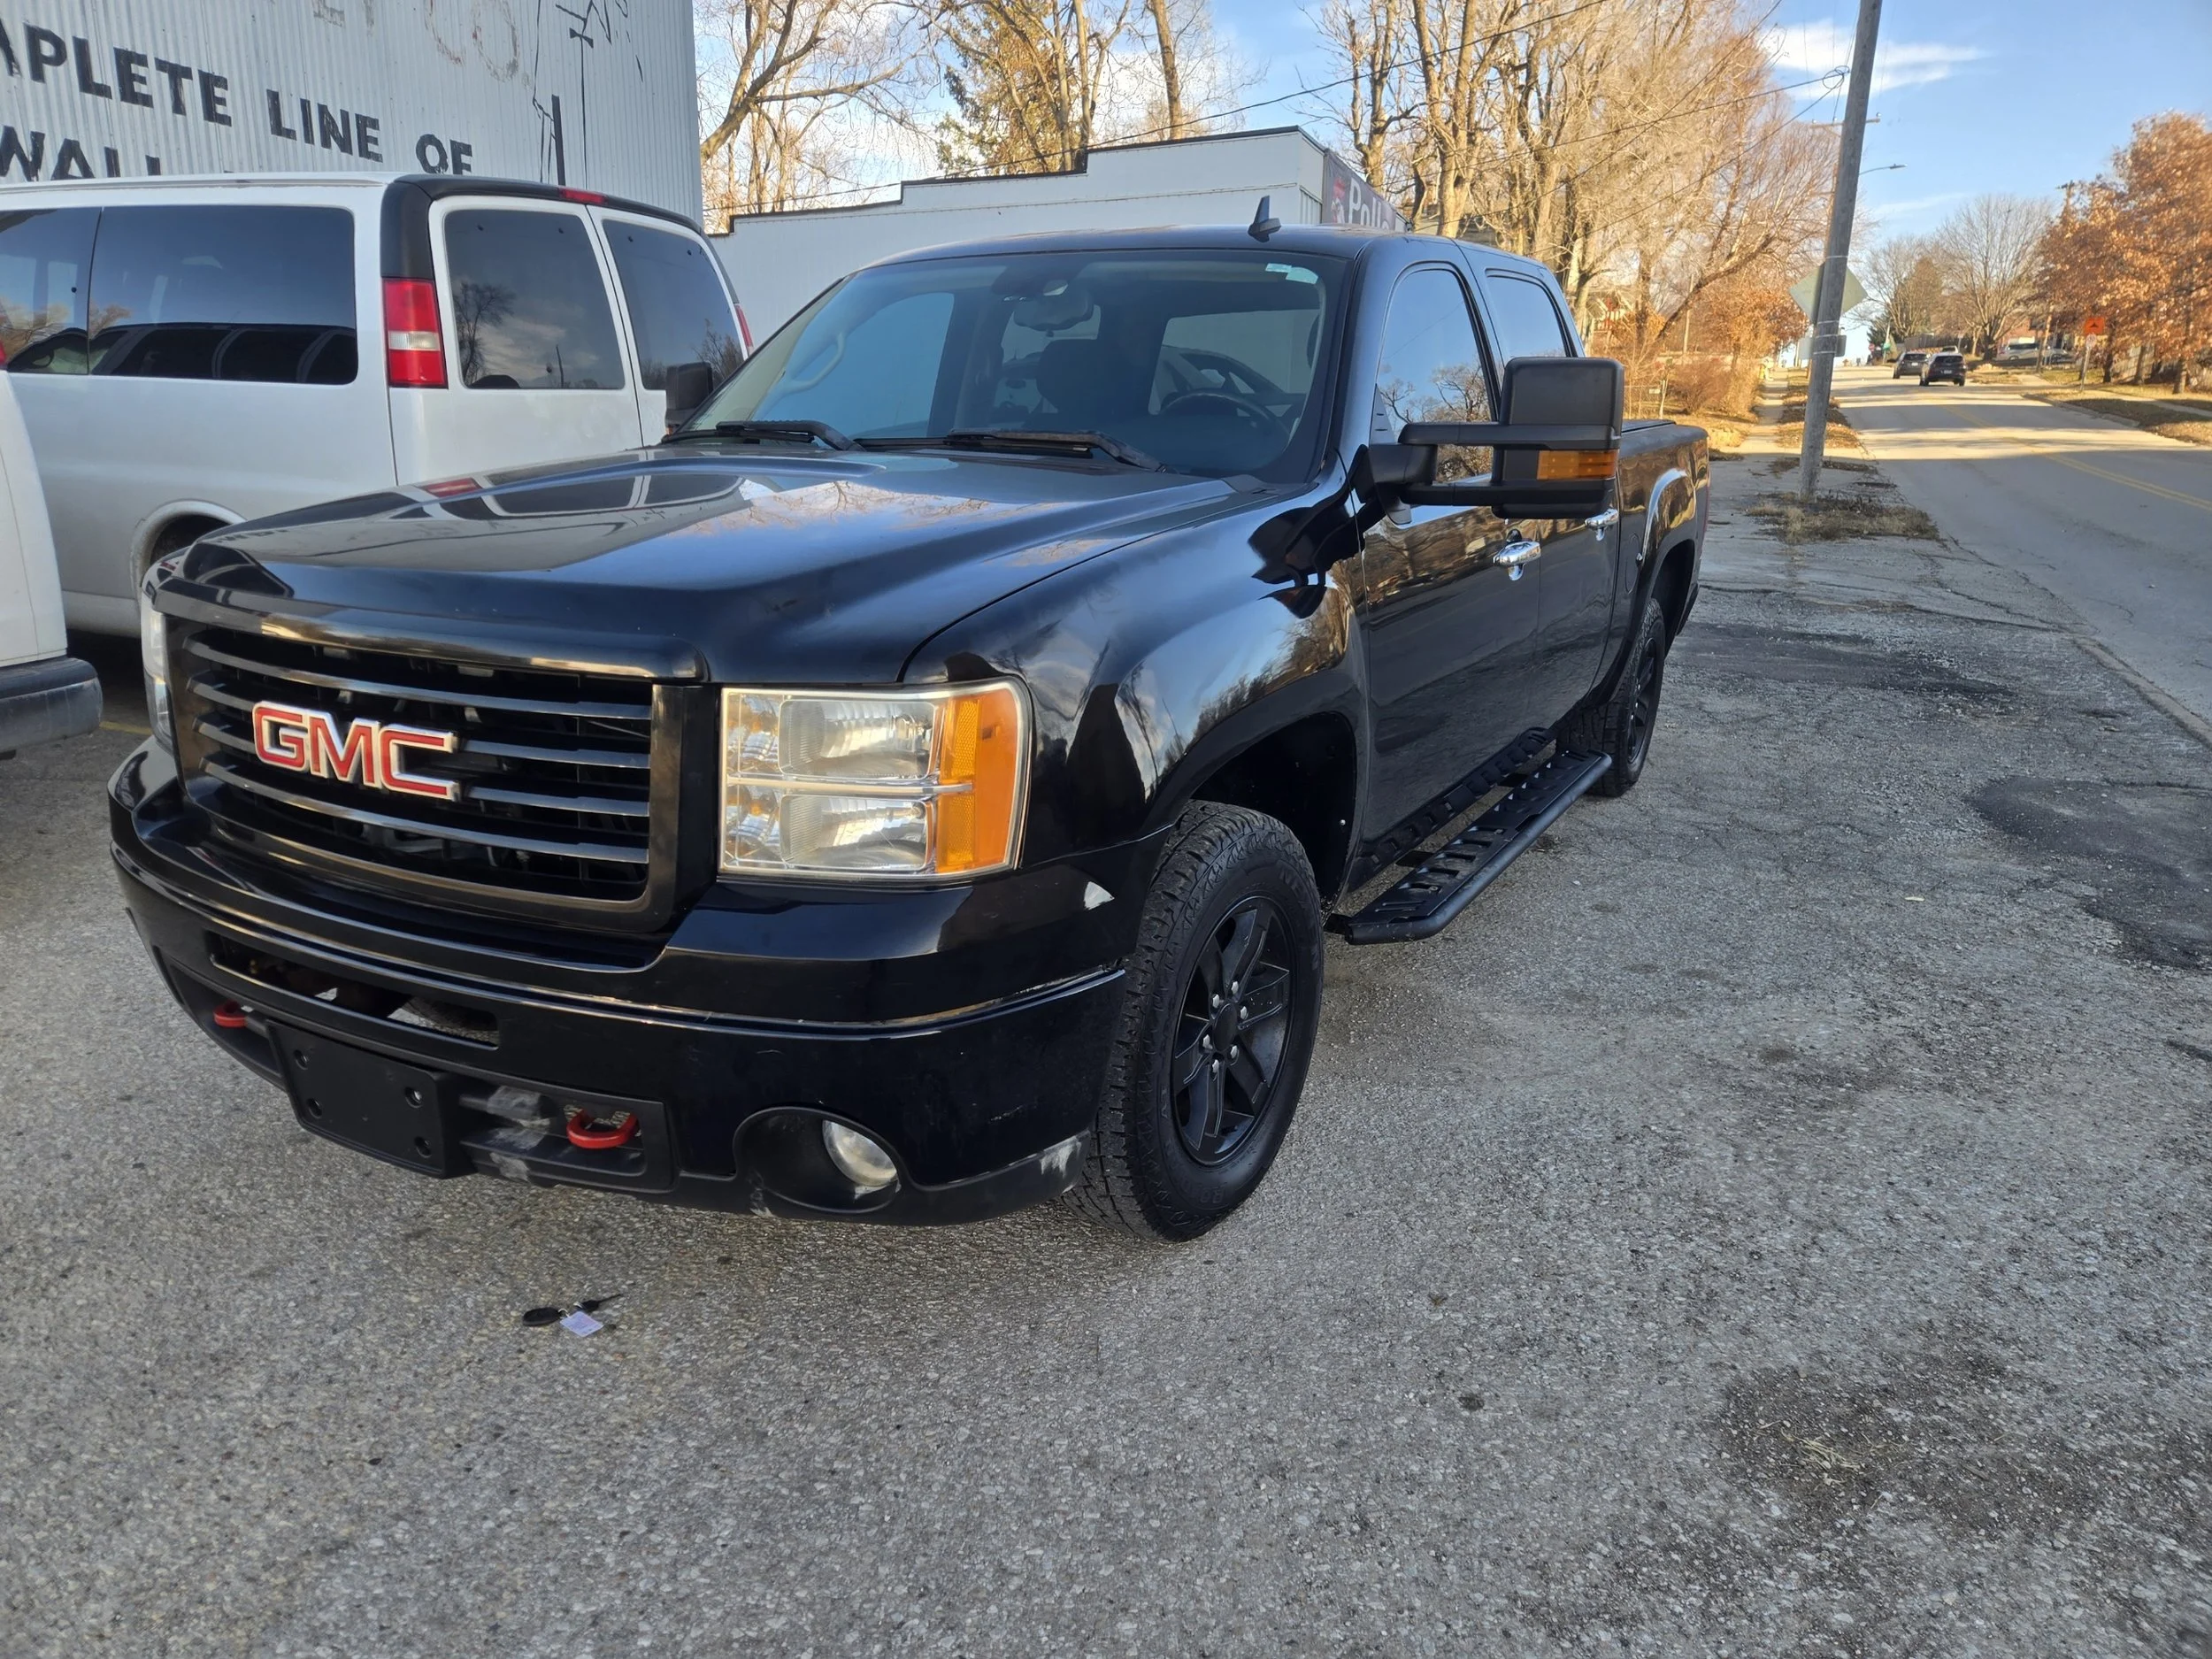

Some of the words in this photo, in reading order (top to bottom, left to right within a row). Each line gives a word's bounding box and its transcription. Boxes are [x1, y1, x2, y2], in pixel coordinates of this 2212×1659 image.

[266, 88, 383, 163] LINE
[416, 134, 472, 175] OF
[252, 700, 460, 802] GMC
